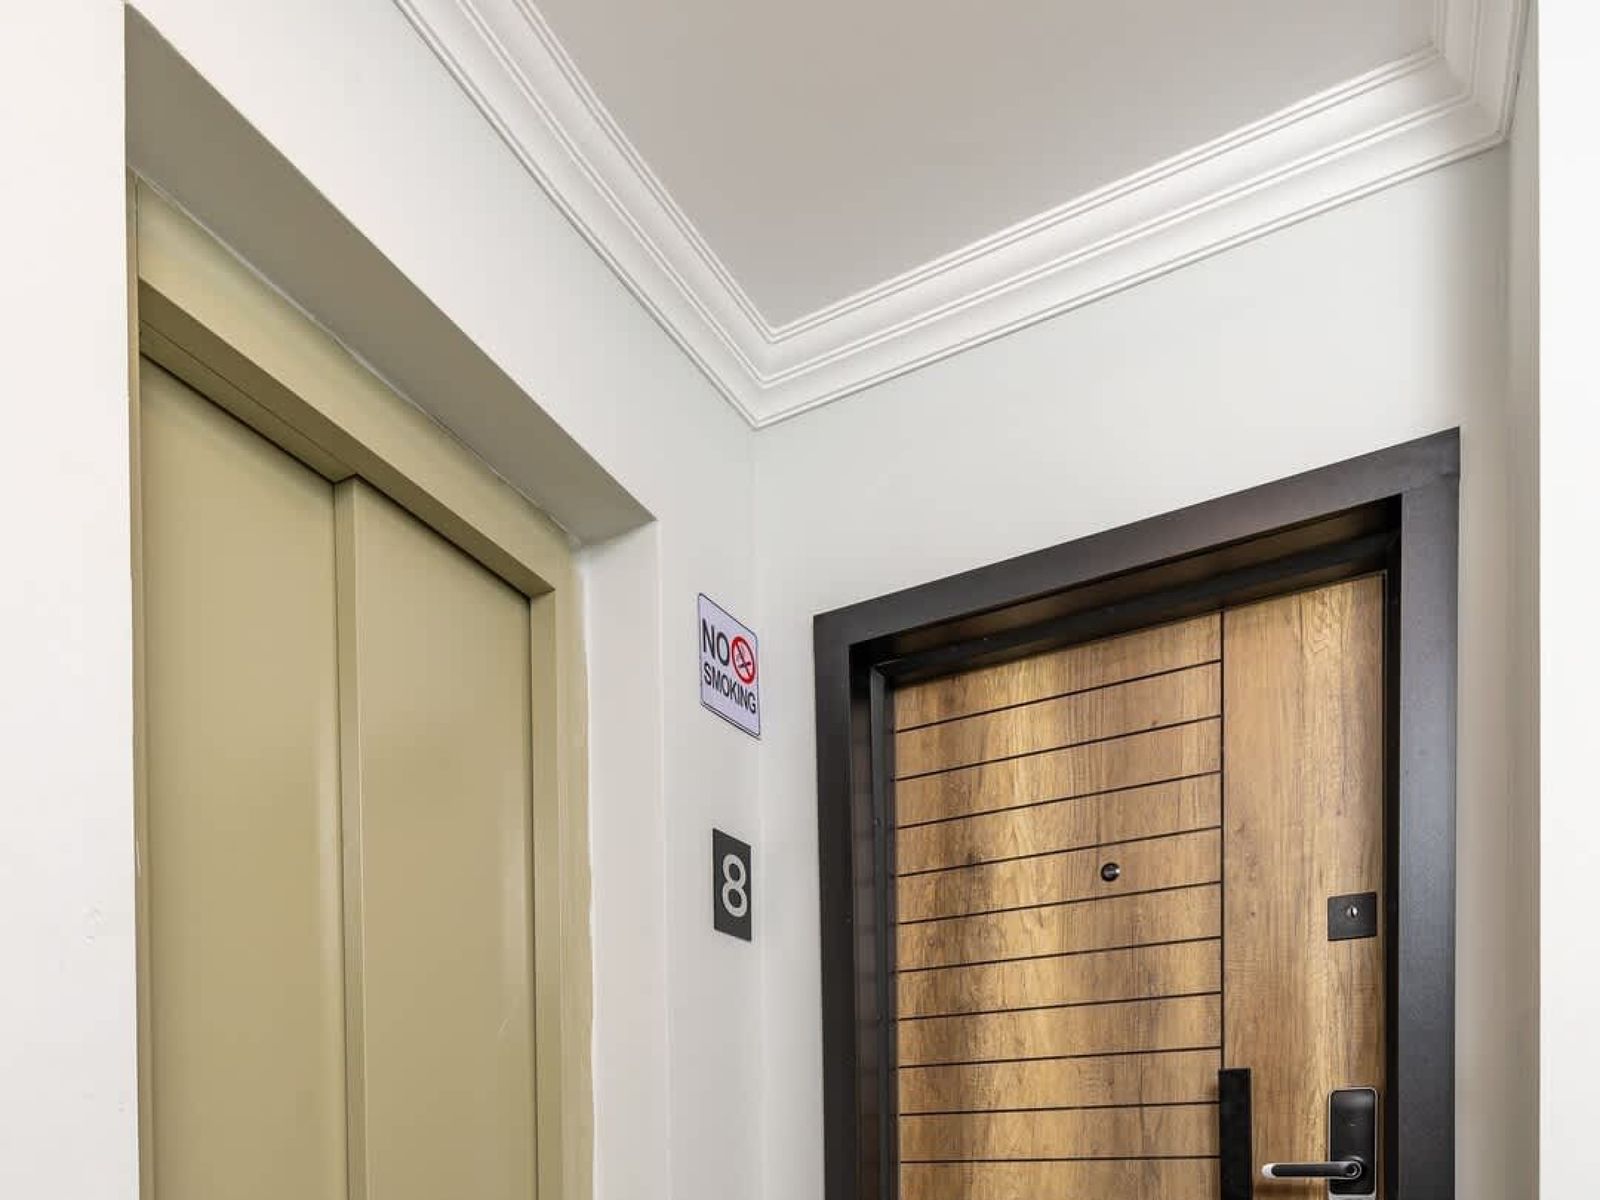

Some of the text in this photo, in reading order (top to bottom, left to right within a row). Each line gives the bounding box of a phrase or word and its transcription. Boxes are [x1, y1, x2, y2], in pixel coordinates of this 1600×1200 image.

[702, 618, 730, 666] NO
[703, 661, 757, 714] SMOKING
[722, 854, 748, 918] 8
